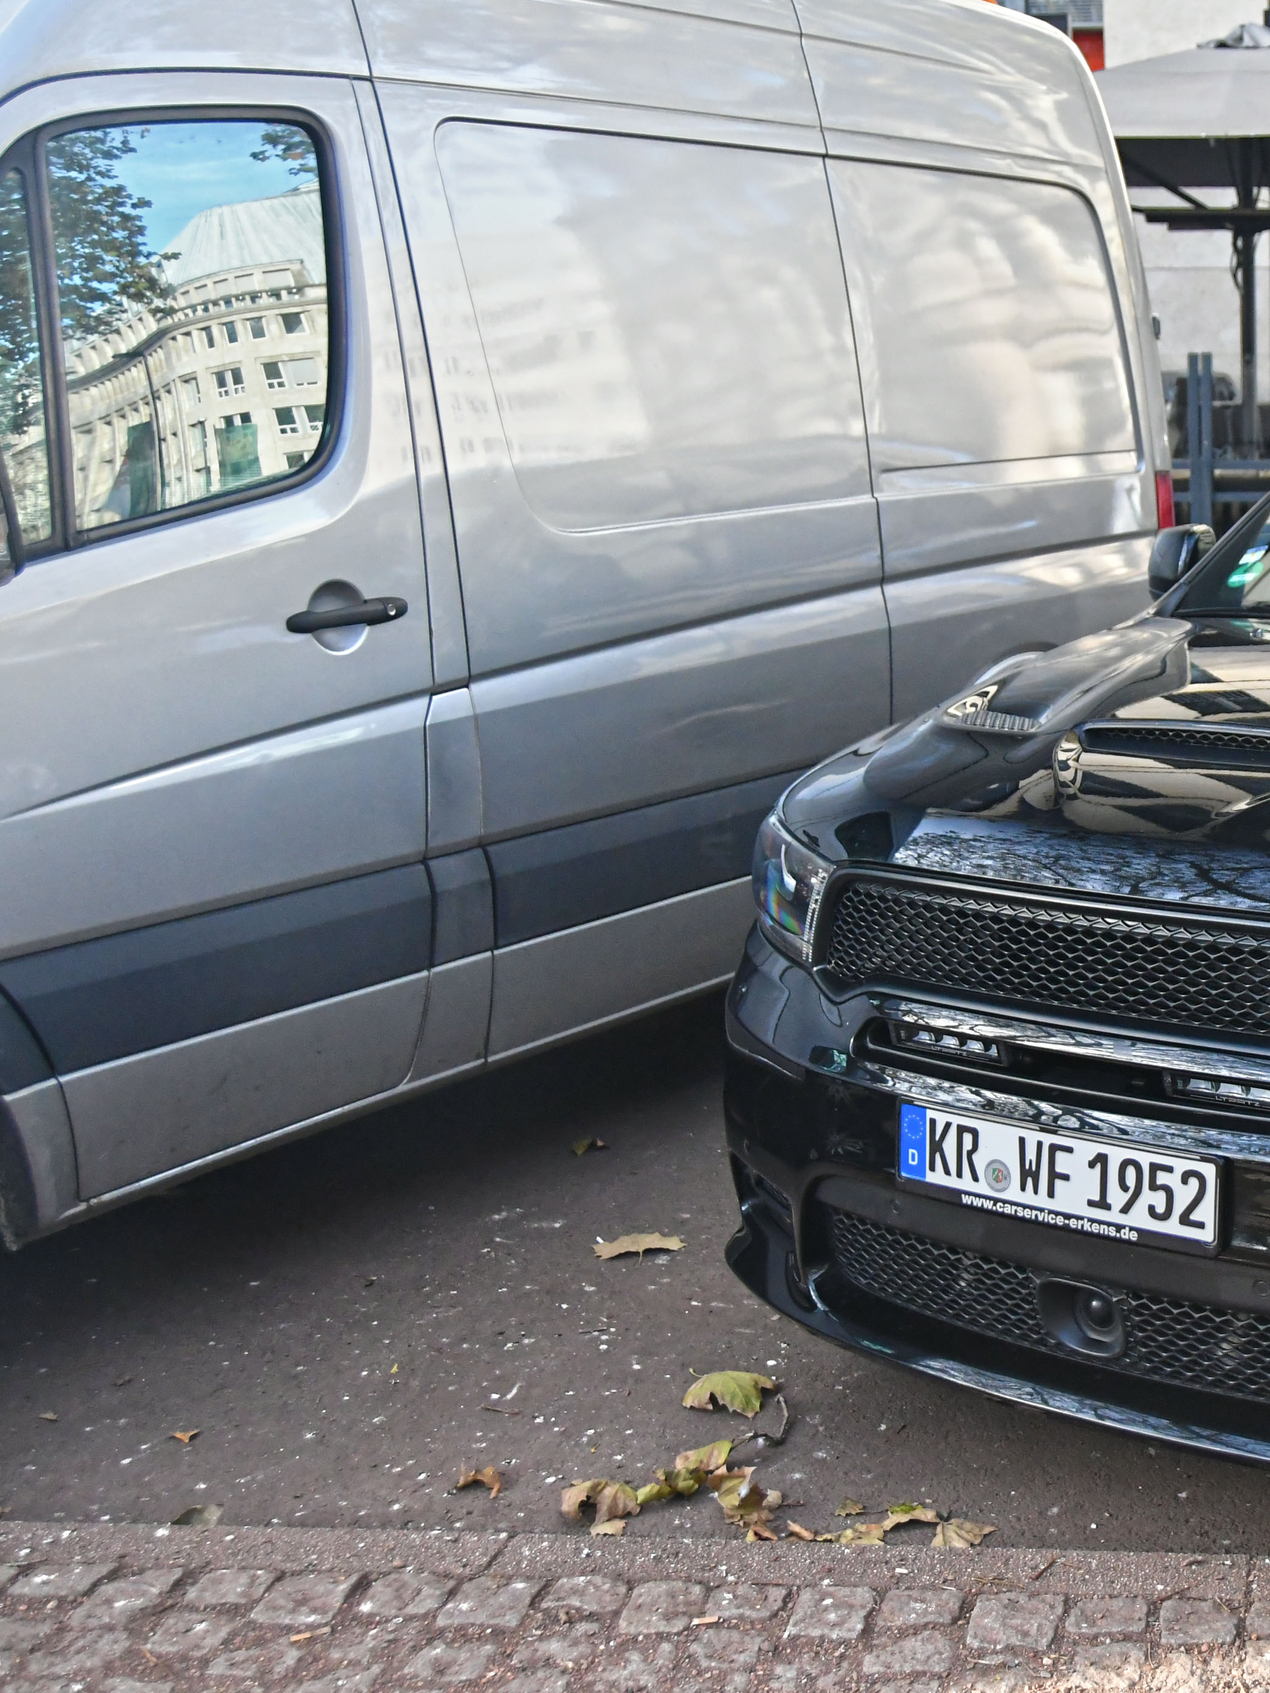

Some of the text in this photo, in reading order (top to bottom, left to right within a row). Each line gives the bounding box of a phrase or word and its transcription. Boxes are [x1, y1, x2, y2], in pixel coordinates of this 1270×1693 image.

[908, 1148, 919, 1166] D
[928, 1117, 980, 1183] KR
[1018, 1135, 1074, 1199] WF
[1086, 1151, 1208, 1230] 1952
[961, 1193, 1139, 1241] www.carservice-erkens.de
